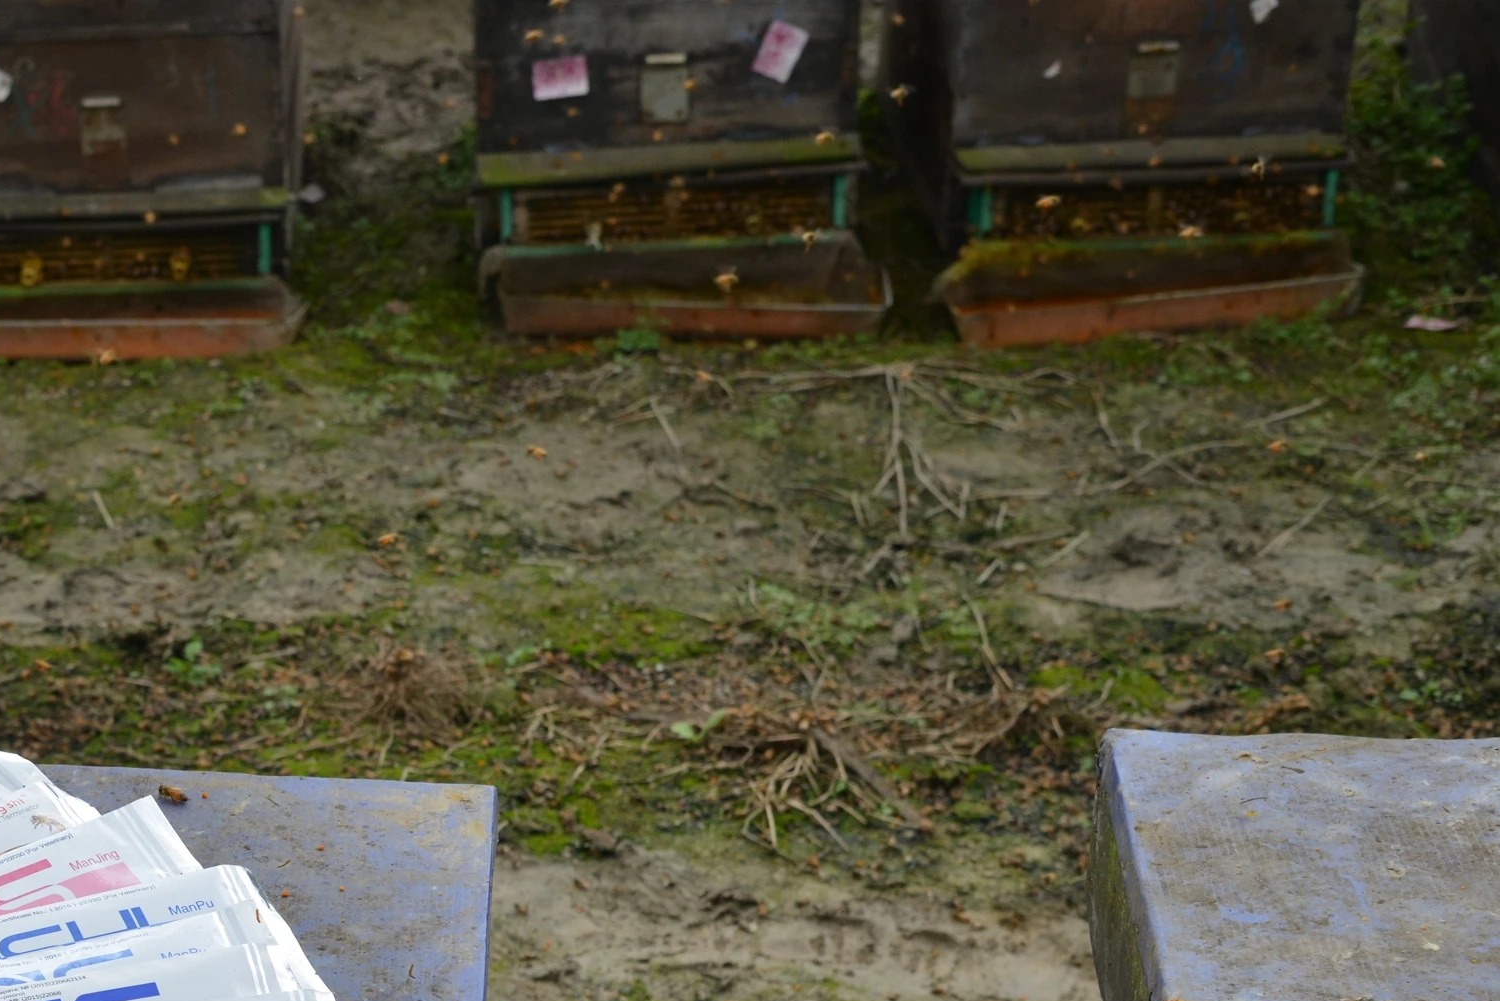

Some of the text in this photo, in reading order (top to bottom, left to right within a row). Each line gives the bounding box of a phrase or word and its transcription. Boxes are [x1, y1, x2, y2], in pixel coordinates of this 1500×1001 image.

[1, 802, 40, 821] Terminator
[68, 850, 121, 872] ManJing
[168, 900, 215, 916] ManPu
